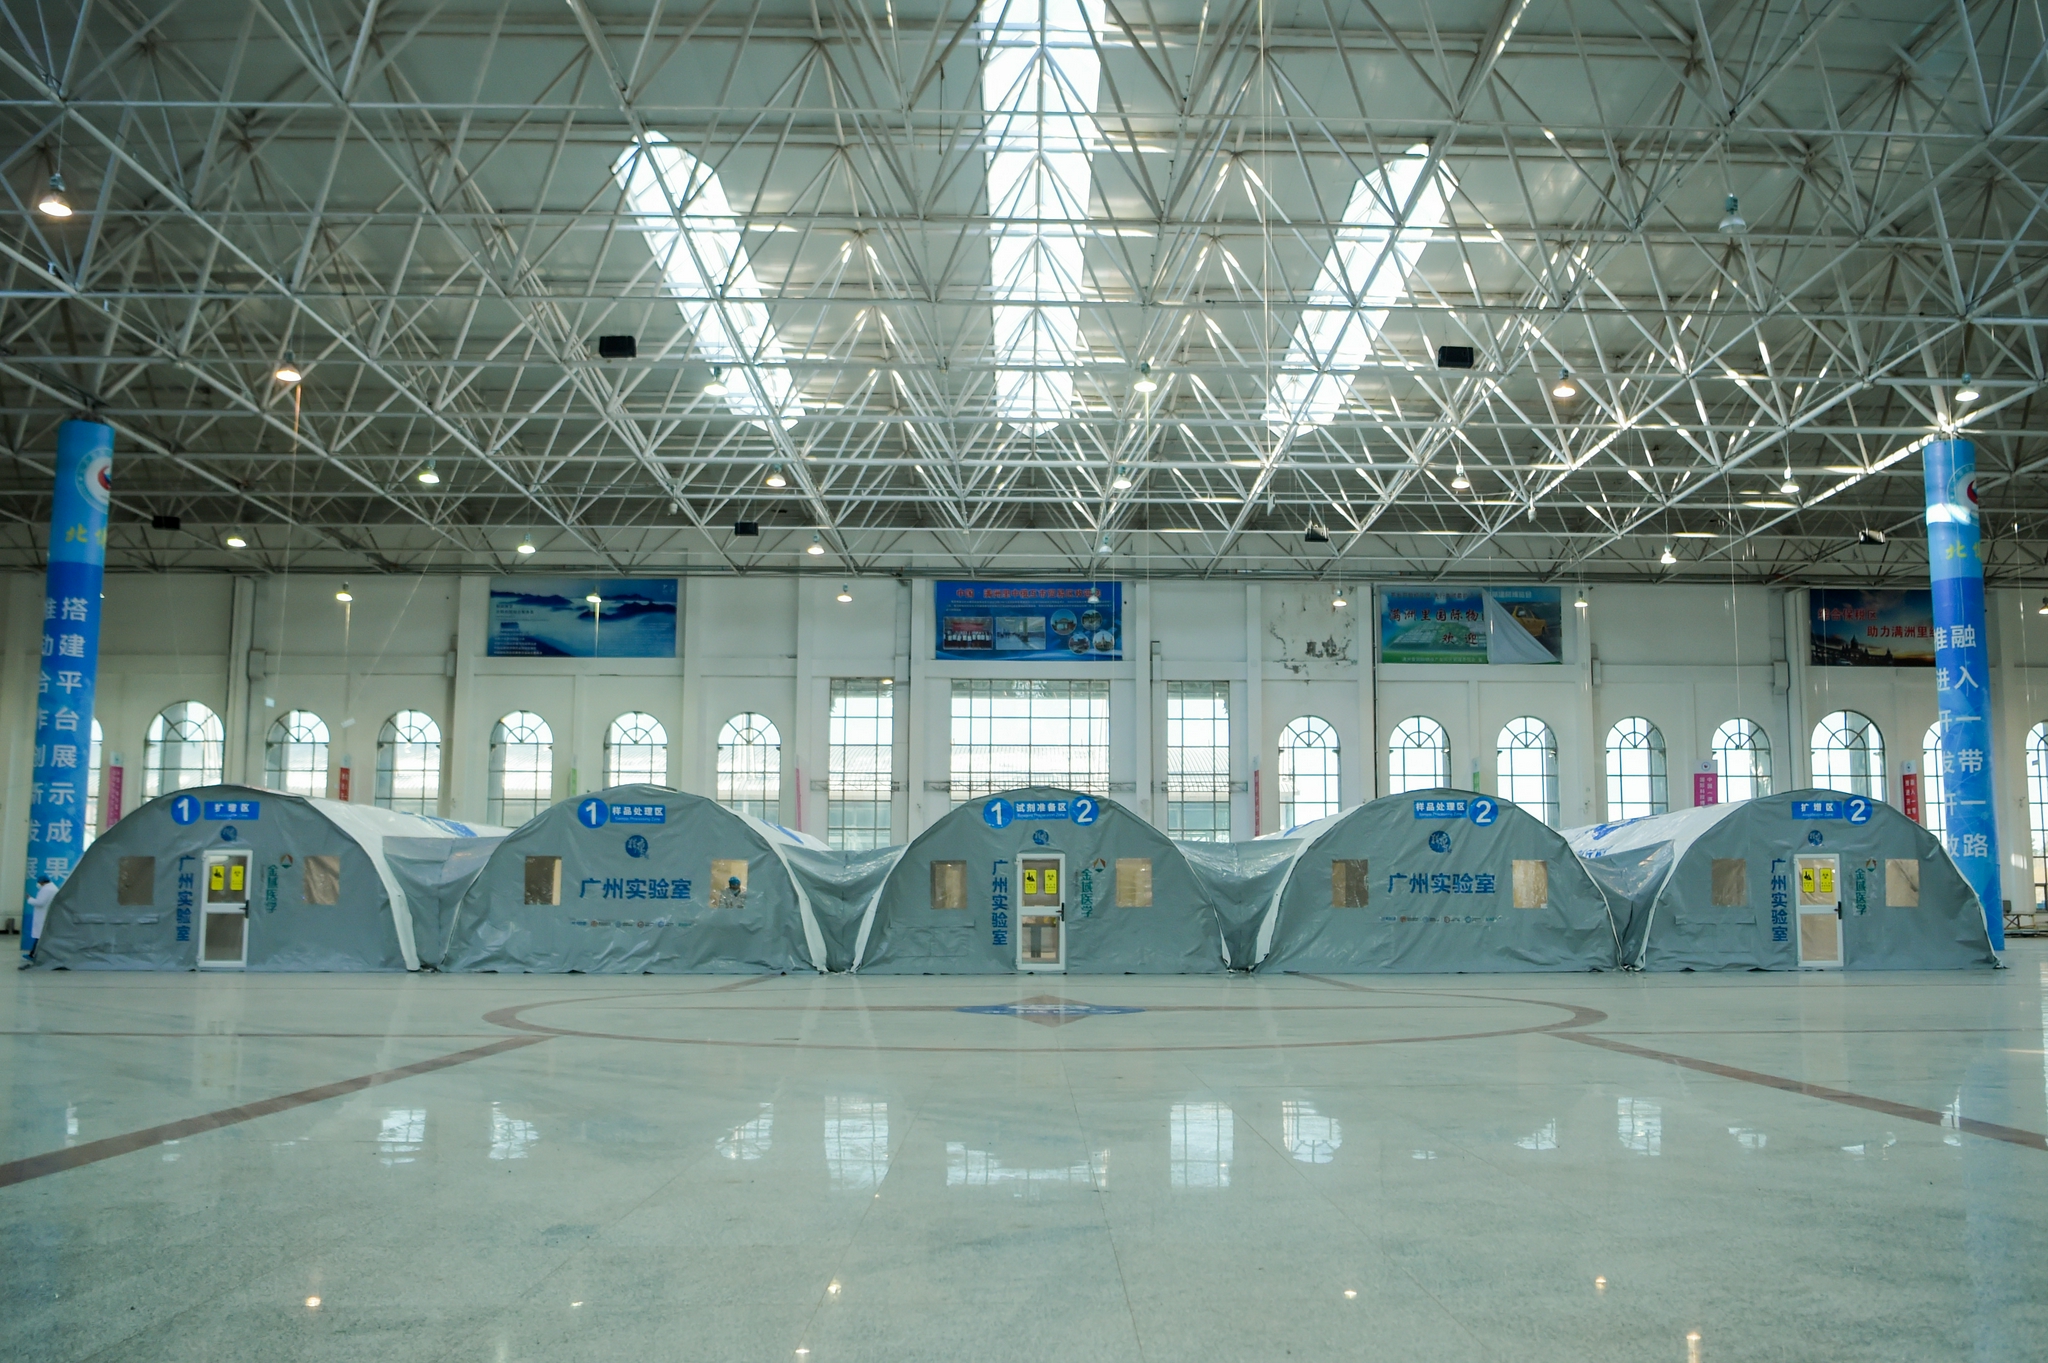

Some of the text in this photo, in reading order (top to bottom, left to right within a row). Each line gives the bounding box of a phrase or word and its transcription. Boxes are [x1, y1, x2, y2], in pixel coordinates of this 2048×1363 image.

[1390, 609, 1486, 622] 满洲里国际物
[44, 597, 88, 880] 搭建平台展示成果
[1950, 624, 1988, 858] 融入一带一路
[178, 799, 190, 822] 1
[214, 803, 250, 813] 扩增区
[586, 801, 597, 825] 1
[612, 806, 664, 816] 样品处理区
[991, 802, 1002, 825] 1
[1016, 802, 1067, 813] 试剂准备区
[1076, 800, 1093, 823] 2
[1416, 802, 1465, 812] 样品处理区
[1476, 800, 1492, 823] 2
[1801, 803, 1833, 812] 扩增区
[1850, 800, 1866, 822] 2
[579, 878, 692, 899] 广州实验室
[1080, 868, 1093, 918] 金域医学
[1387, 873, 1496, 894] 广州实验室
[176, 855, 195, 941] 广州实验室
[992, 859, 1008, 946] 广州实验室
[1771, 858, 1788, 942] 广州实验室
